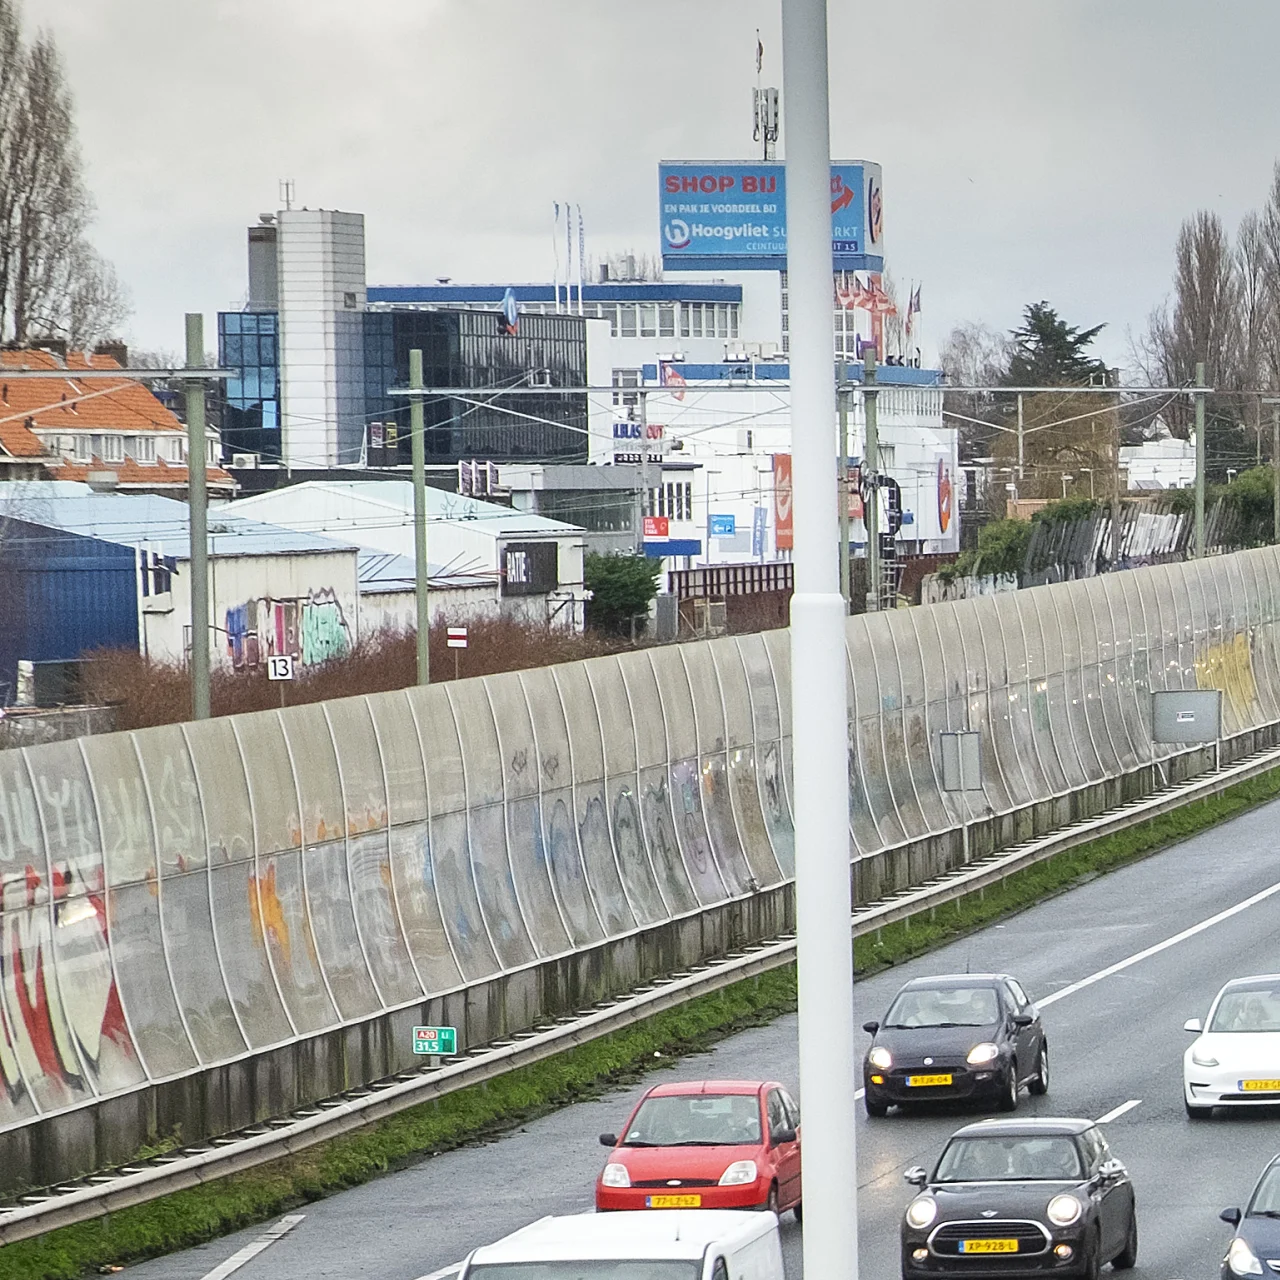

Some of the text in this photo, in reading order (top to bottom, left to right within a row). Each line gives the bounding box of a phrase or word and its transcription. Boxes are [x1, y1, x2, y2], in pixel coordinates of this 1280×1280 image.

[665, 175, 776, 193] SHOP BIJ
[664, 204, 678, 213] EN
[679, 204, 698, 213] PAK
[699, 204, 711, 213] JE
[712, 204, 761, 213] VOORDEEL
[692, 223, 769, 240] Hoogvliet
[746, 242, 787, 251] CEINTUU
[271, 659, 289, 677] 13
